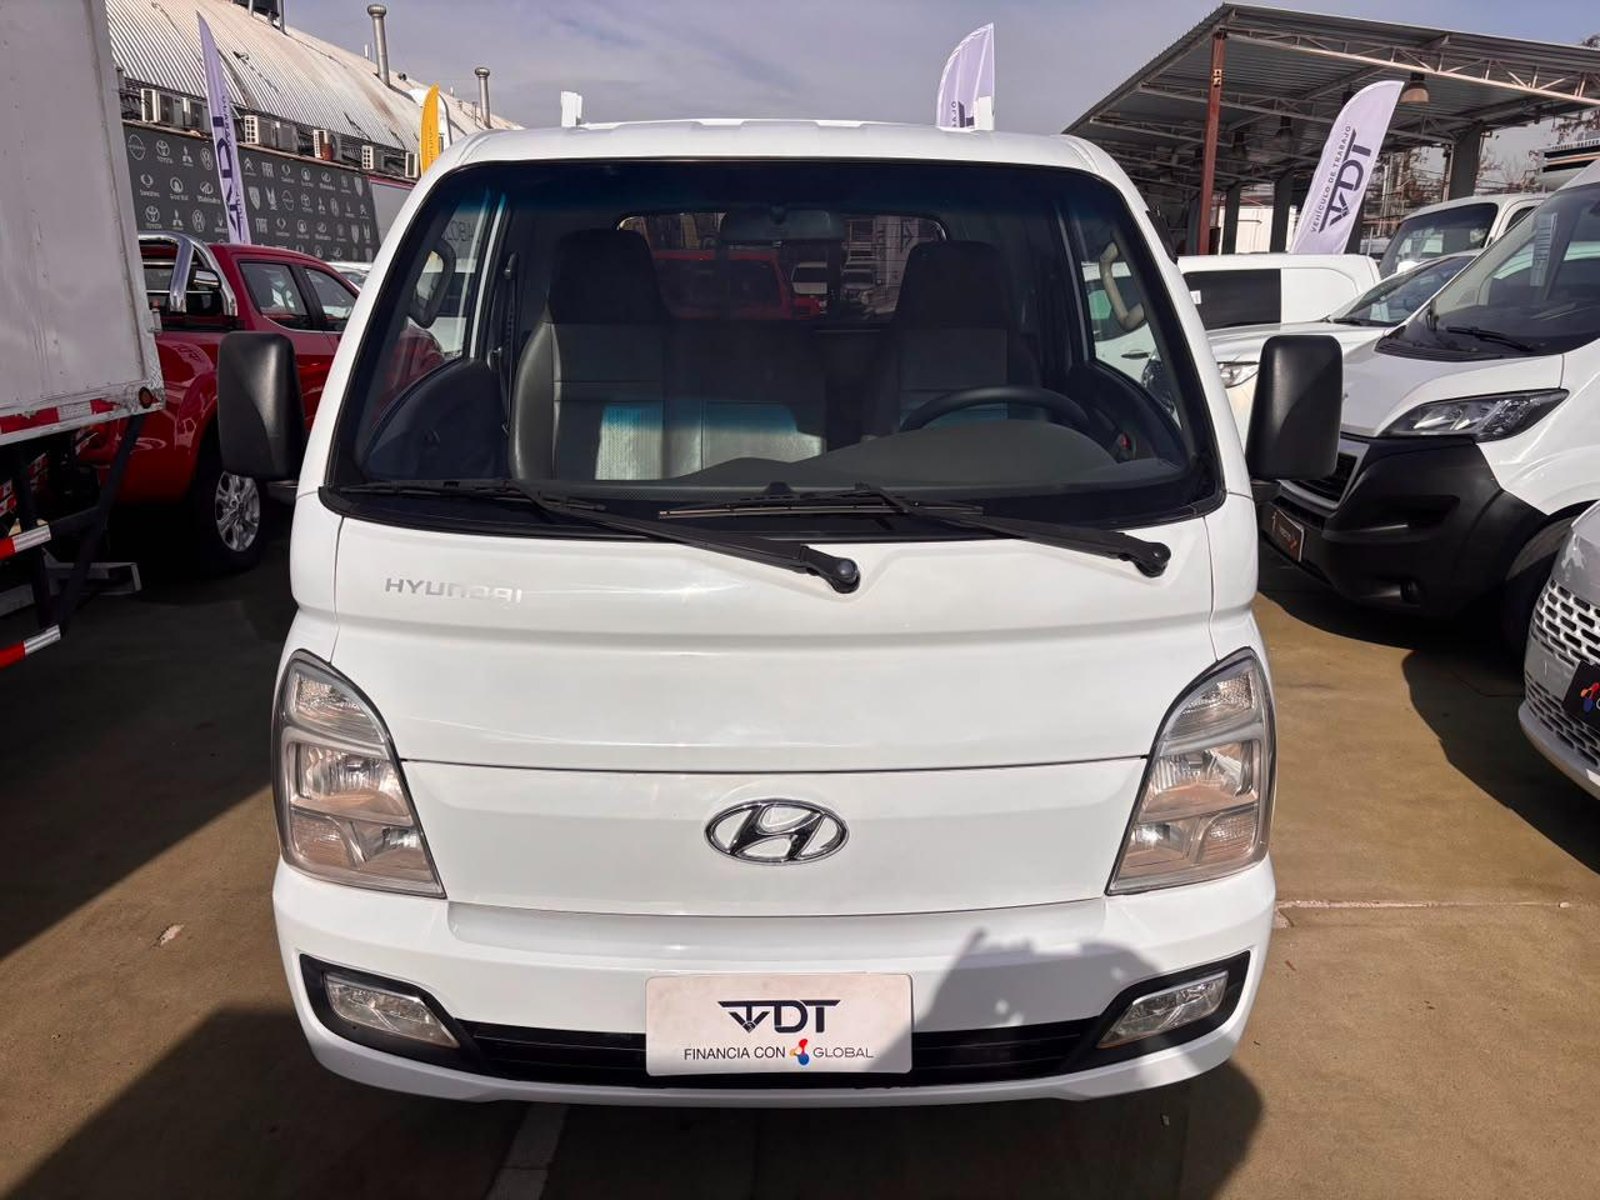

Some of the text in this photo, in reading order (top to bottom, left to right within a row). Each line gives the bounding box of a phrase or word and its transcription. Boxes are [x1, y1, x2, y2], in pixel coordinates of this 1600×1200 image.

[1333, 125, 1352, 168] TRABAJO
[684, 1045, 874, 1061] FINANCIA CON GLOBAL
